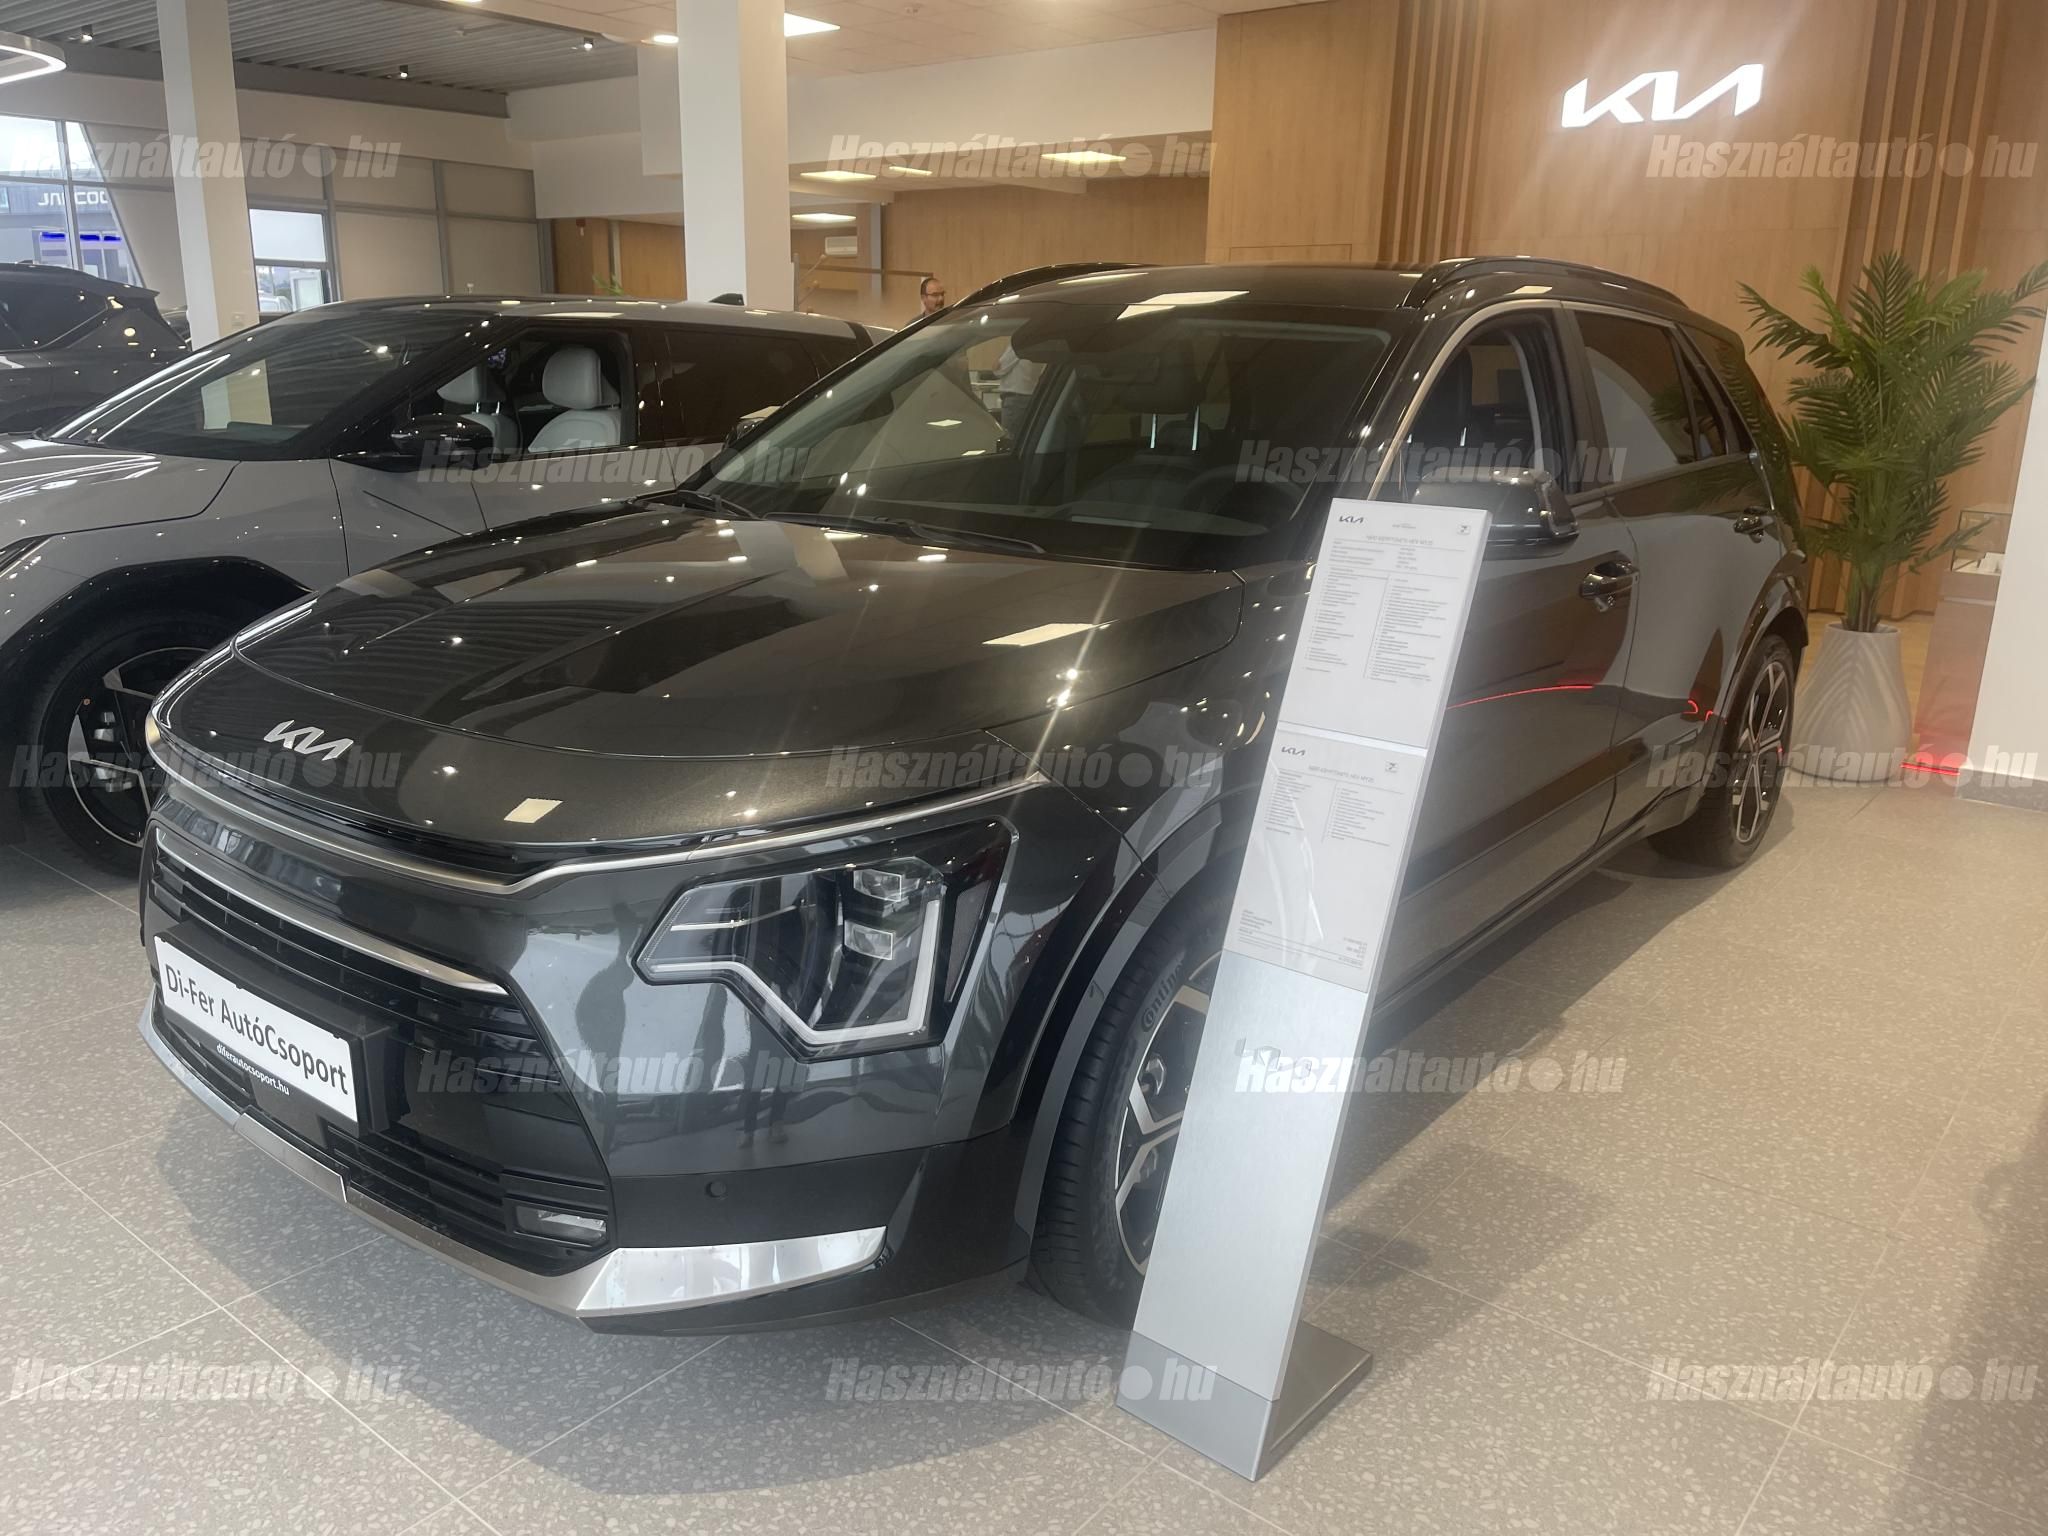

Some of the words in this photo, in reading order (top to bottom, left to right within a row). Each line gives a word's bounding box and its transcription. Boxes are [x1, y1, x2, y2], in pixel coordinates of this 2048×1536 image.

[1561, 63, 1765, 128] KIA
[263, 719, 355, 762] KIA
[165, 963, 215, 1018] Di-Fer
[220, 997, 349, 1095] AutóCsoport
